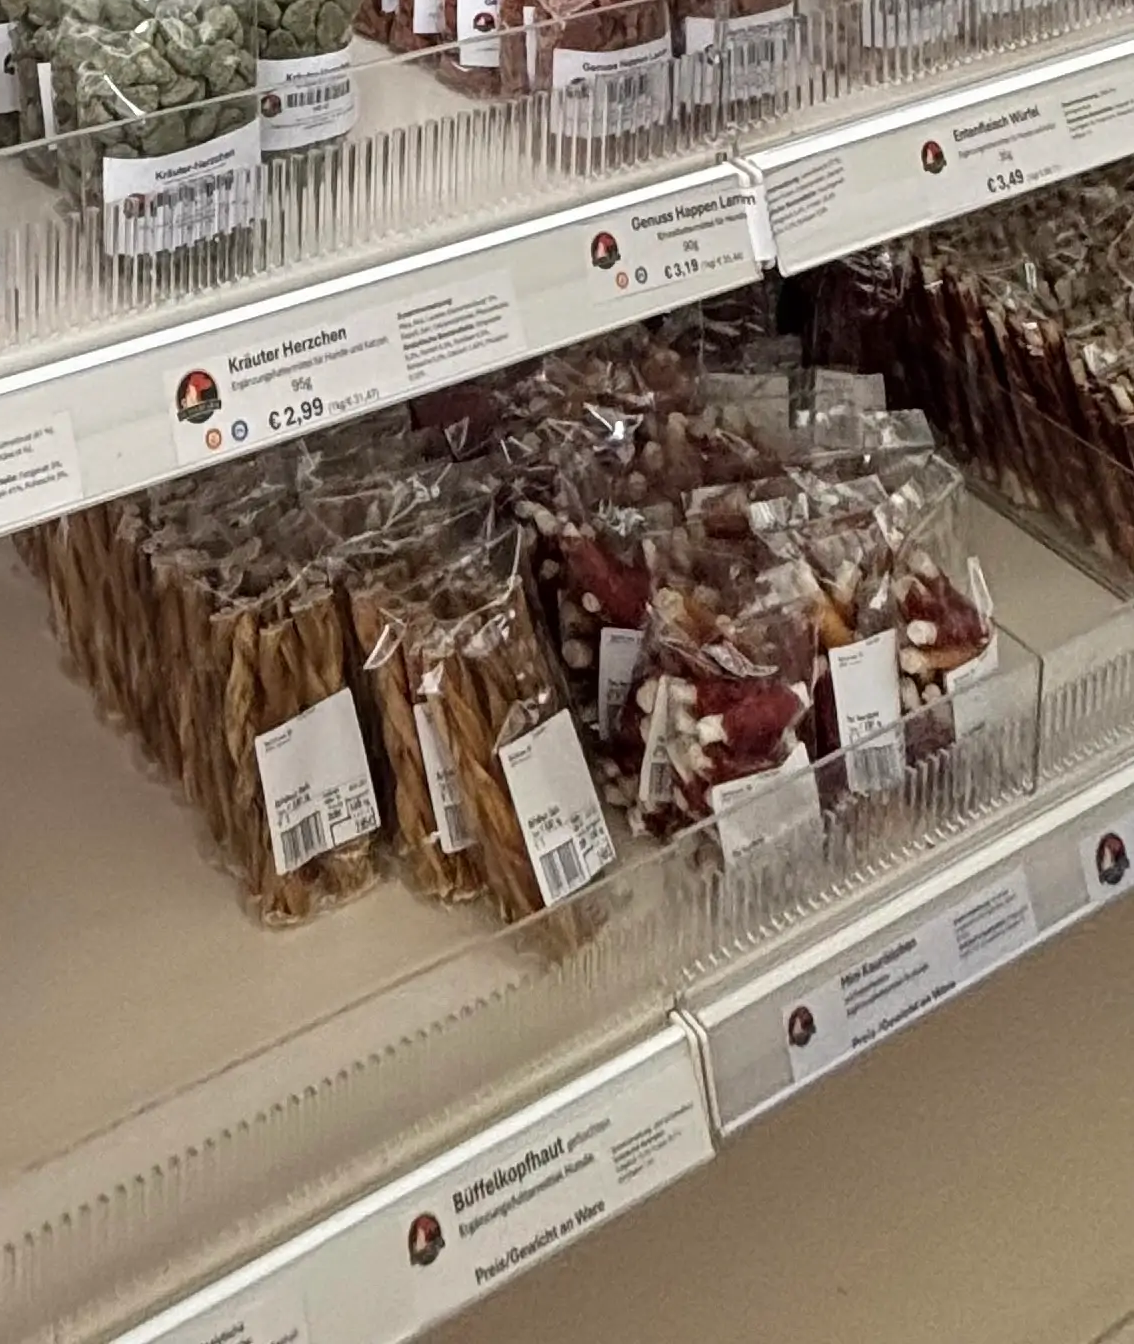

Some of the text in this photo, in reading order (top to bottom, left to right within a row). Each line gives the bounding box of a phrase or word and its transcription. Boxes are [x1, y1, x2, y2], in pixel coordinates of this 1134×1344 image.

[996, 168, 1024, 192] 3,49
[630, 211, 674, 232] Genuss
[675, 200, 718, 221] Happen
[674, 258, 700, 279] 3,19
[228, 327, 348, 375] Kräuter Herzchen
[284, 396, 324, 427] 2,99
[452, 1135, 566, 1214] Büffelkopfhaut
[474, 1224, 559, 1286] Preis/Gewicht
[574, 1199, 606, 1227] Ware
